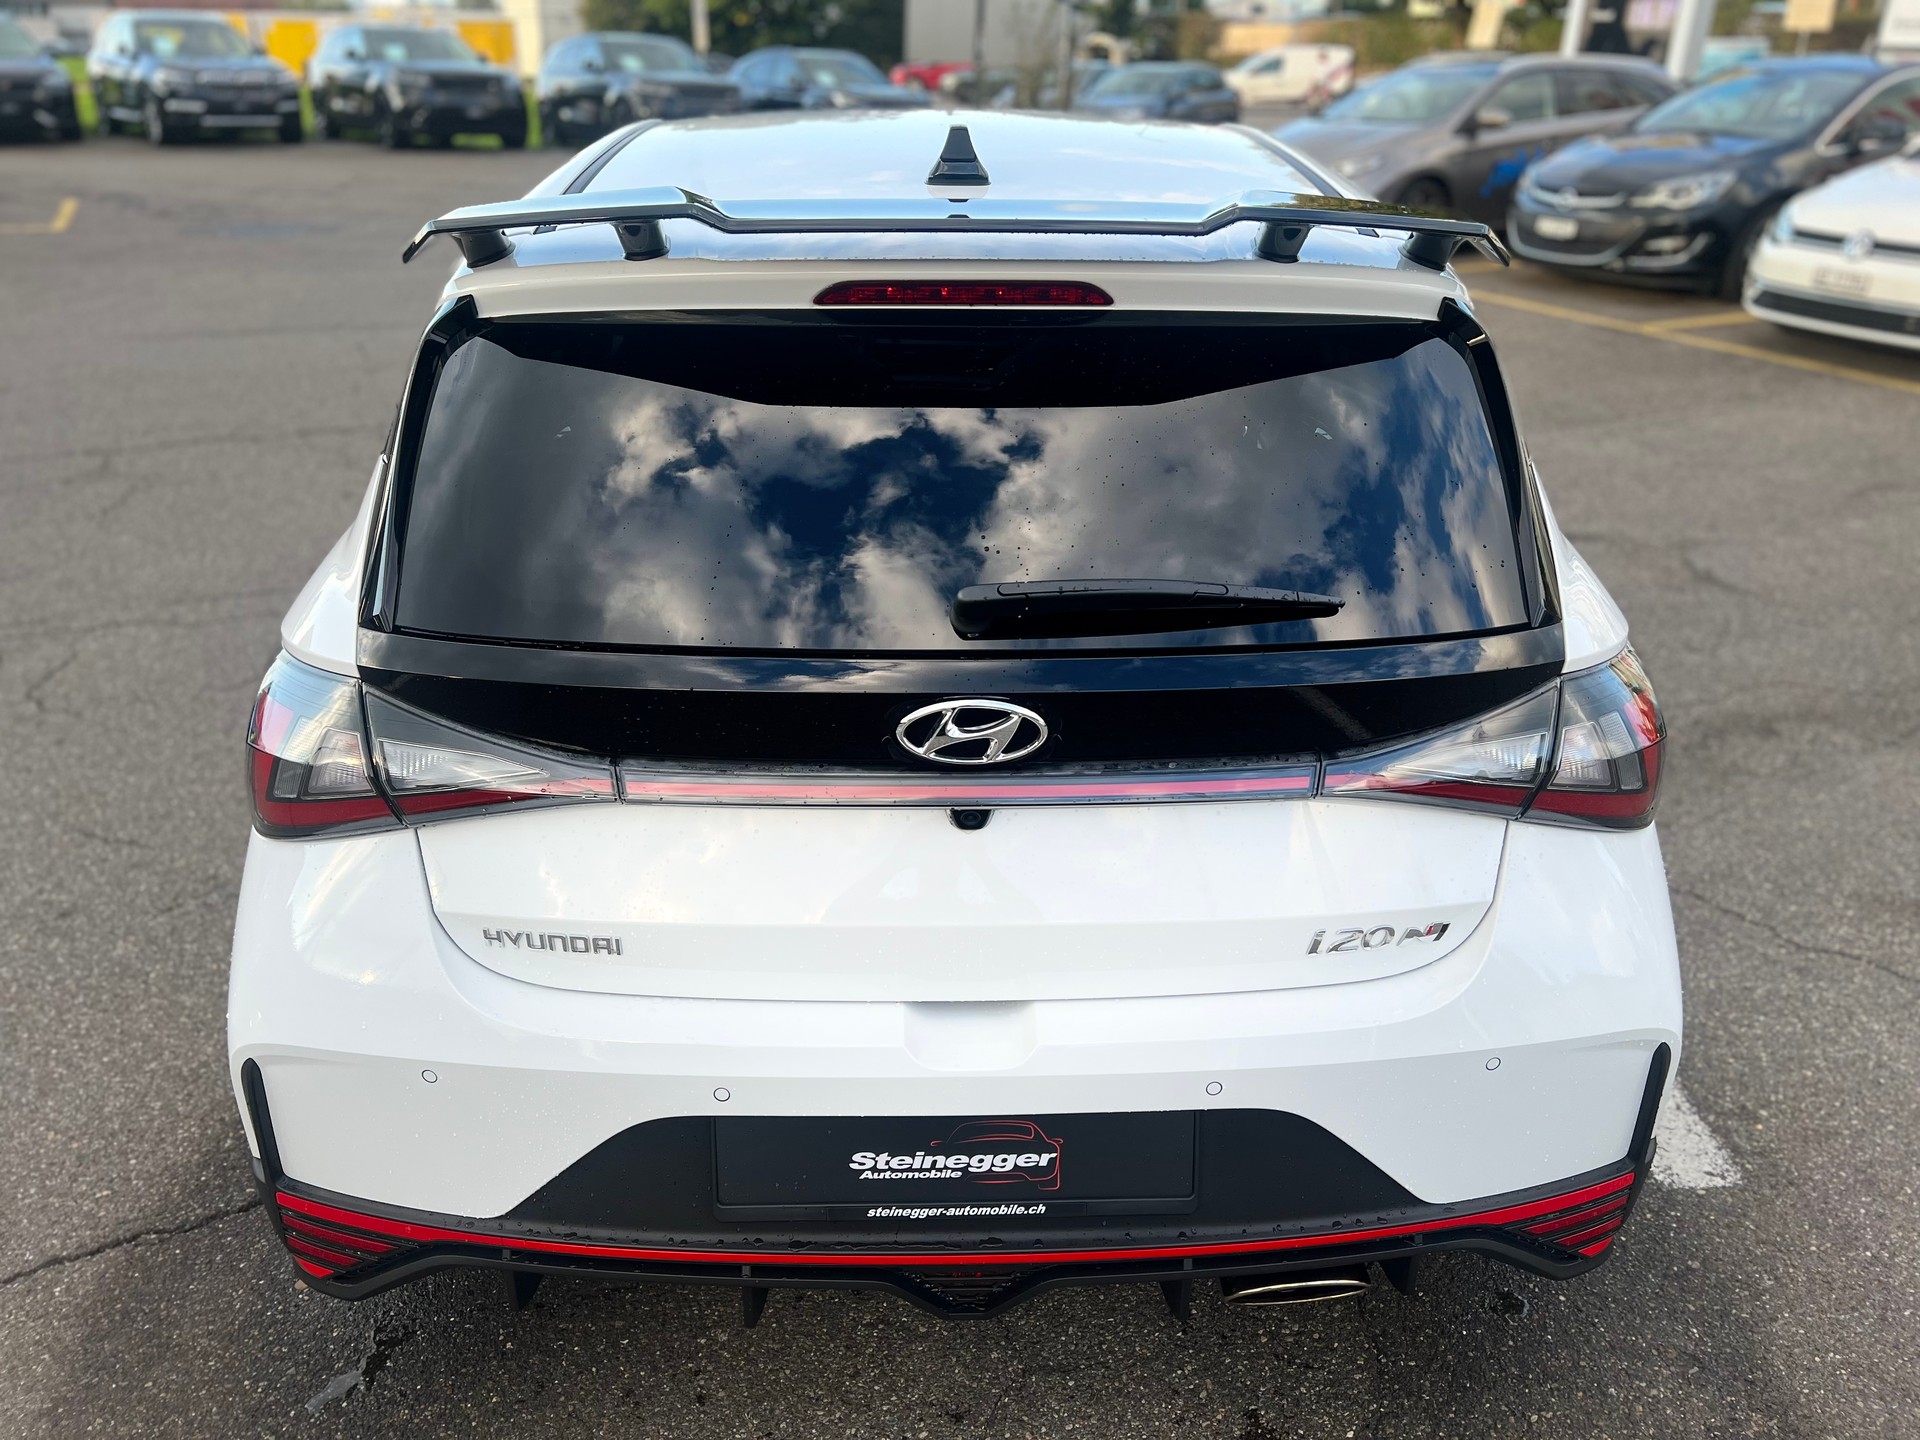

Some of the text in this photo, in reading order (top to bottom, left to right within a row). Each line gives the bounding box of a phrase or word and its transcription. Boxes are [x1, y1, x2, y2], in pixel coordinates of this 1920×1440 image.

[483, 927, 623, 955] HYUNDAI
[849, 1151, 1058, 1173] Steinegger
[858, 1169, 963, 1180] Automobile
[866, 1203, 1047, 1220] steinegger-automobile.ch
